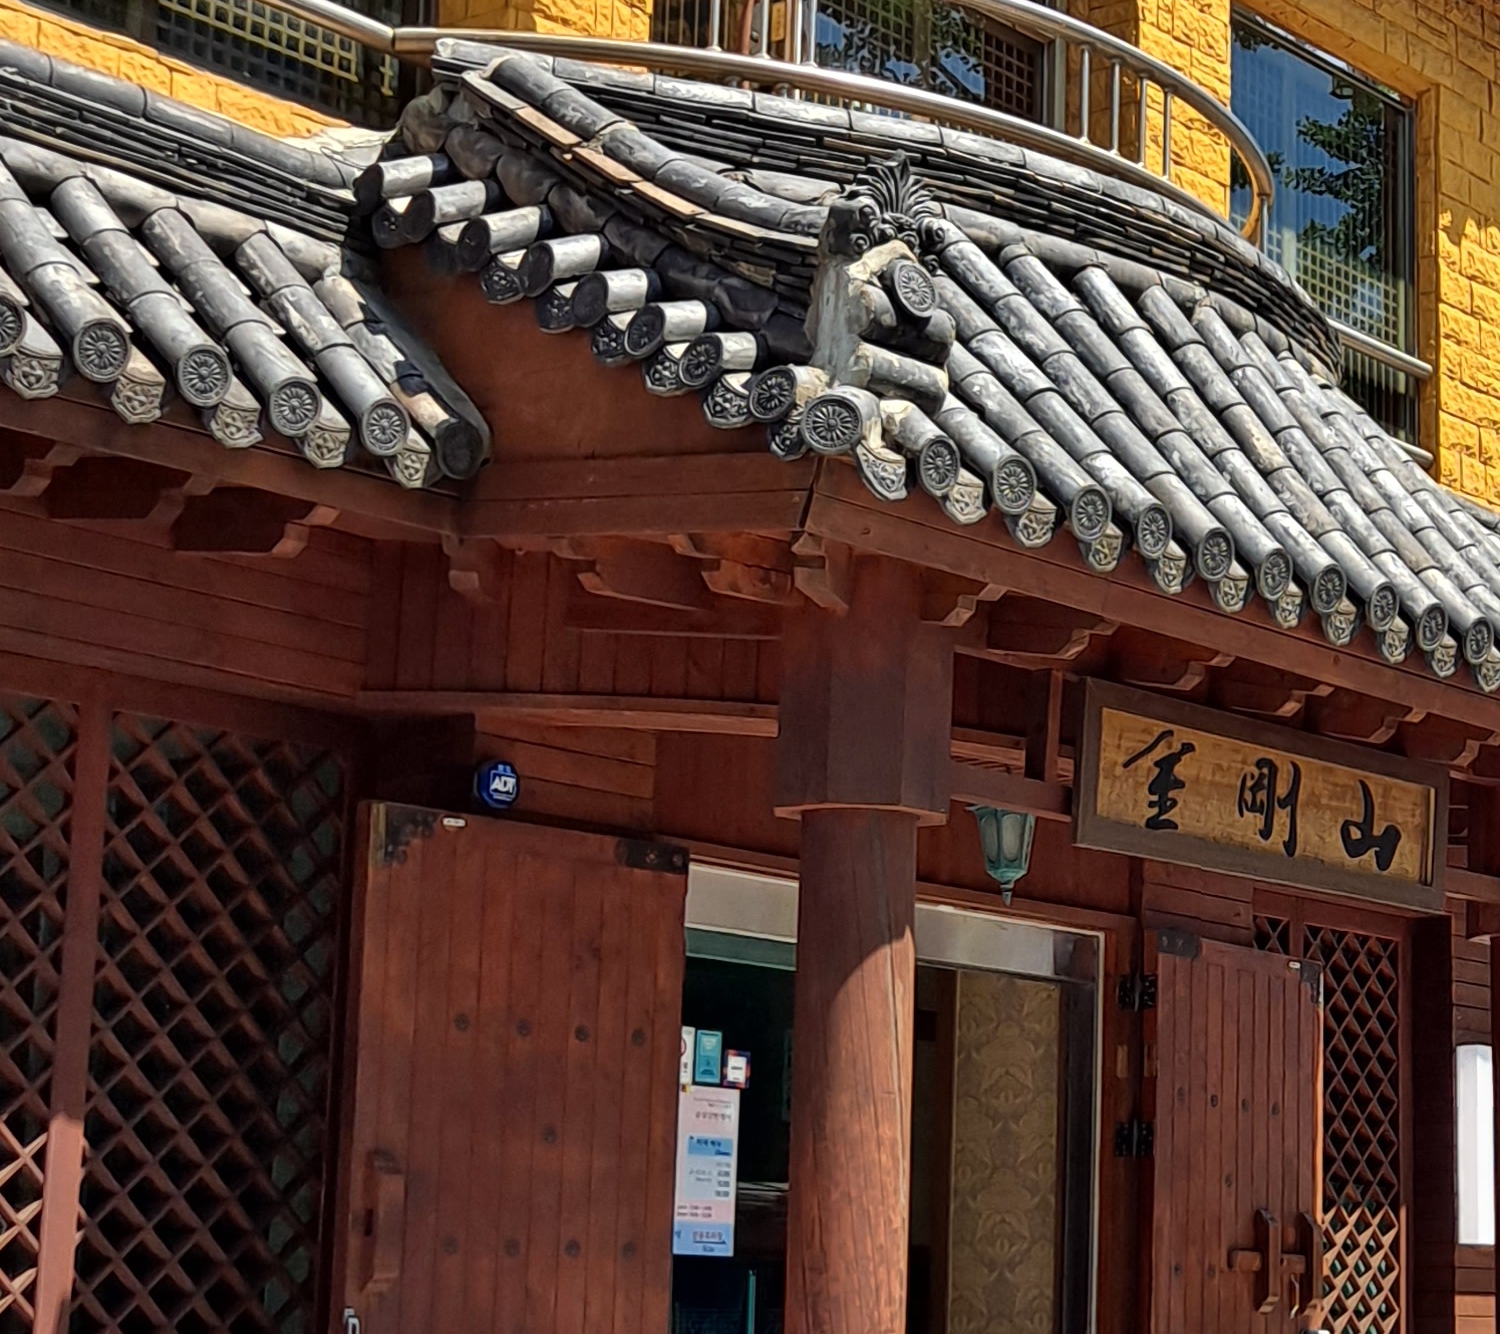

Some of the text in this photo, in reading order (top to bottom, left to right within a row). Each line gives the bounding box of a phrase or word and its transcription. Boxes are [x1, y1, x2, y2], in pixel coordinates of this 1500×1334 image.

[490, 775, 517, 794] ADT
[1122, 729, 1401, 872] 金剛山
